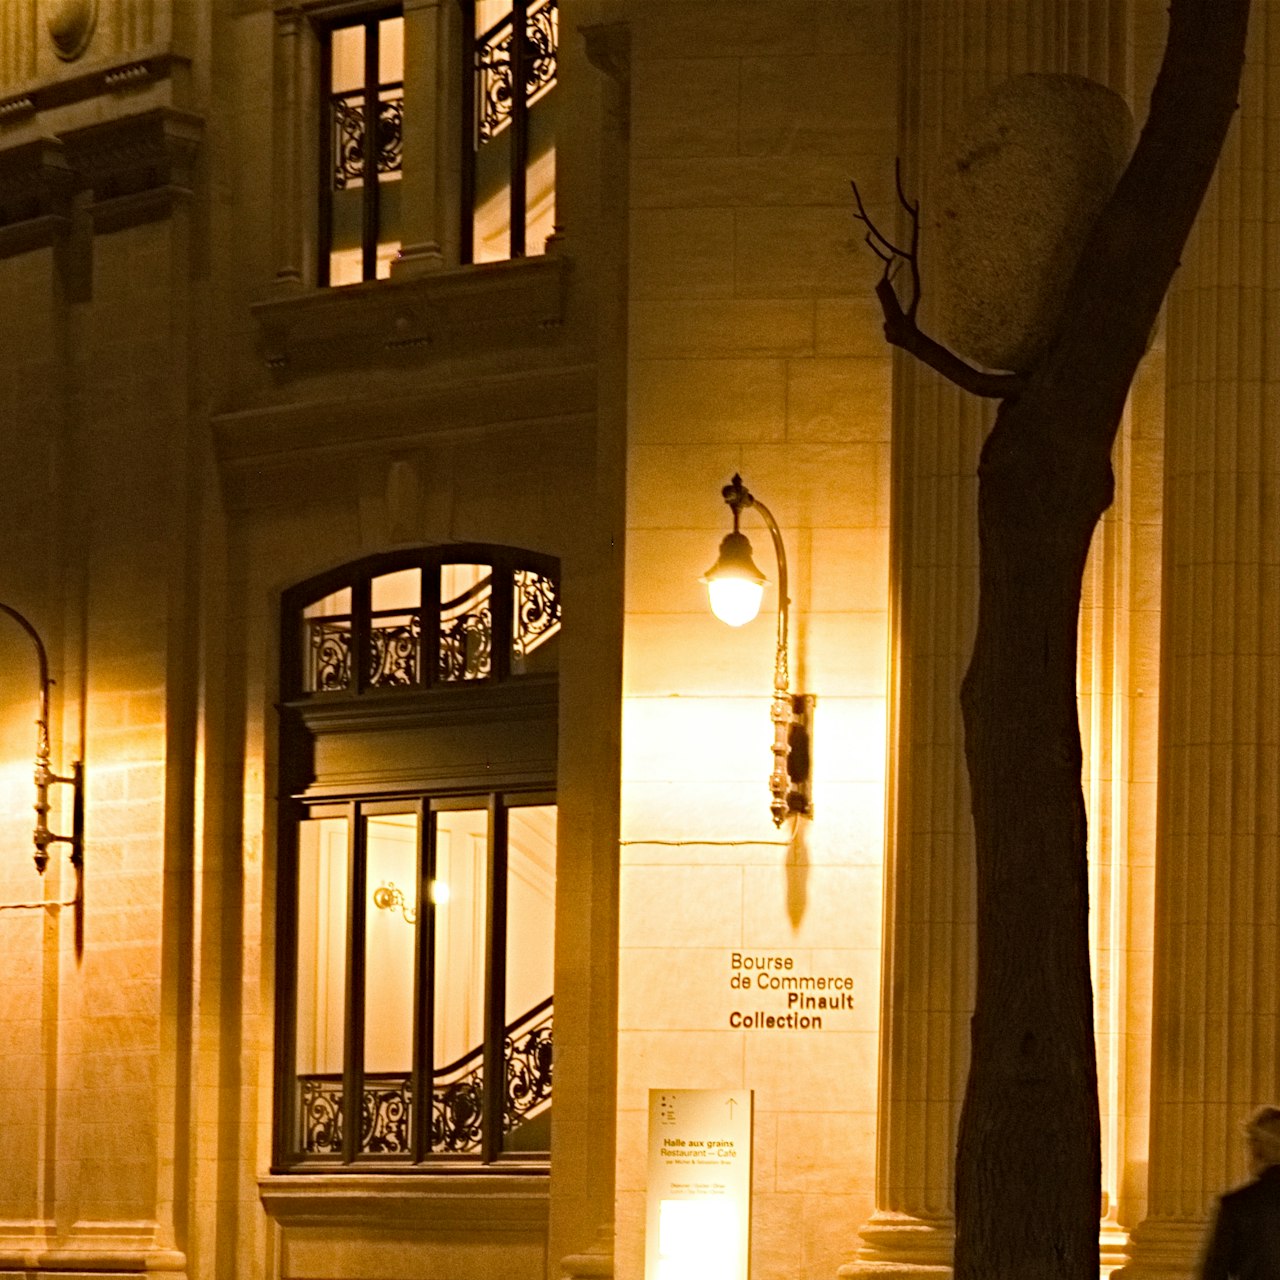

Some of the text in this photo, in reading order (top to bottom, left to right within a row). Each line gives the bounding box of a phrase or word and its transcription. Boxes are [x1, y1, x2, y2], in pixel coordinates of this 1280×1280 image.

[731, 952, 794, 970] Bourse
[730, 972, 854, 991] de Commerce
[787, 992, 854, 1010] Pinault
[729, 1011, 822, 1029] Collection
[660, 1148, 706, 1157] Restaurant
[663, 1138, 686, 1147] Halle
[706, 1139, 734, 1149] grains
